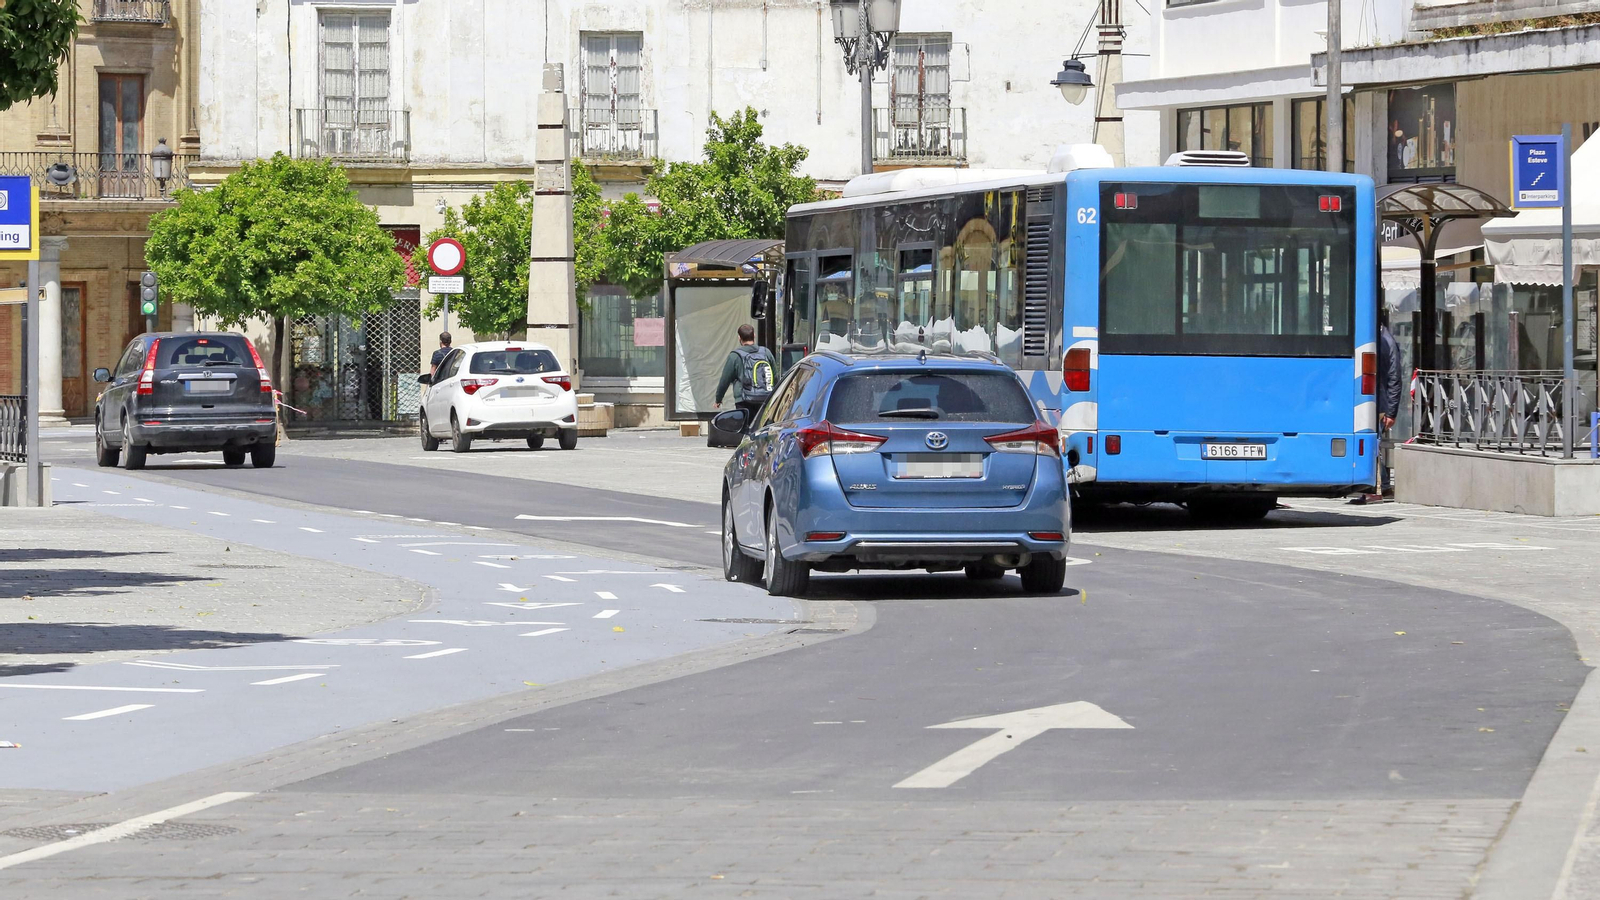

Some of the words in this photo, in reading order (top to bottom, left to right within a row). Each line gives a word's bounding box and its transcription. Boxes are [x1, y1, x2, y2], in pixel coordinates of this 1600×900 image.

[1077, 207, 1097, 224] 62
[1210, 445, 1238, 457] 6166
[1243, 445, 1264, 457] FFW
